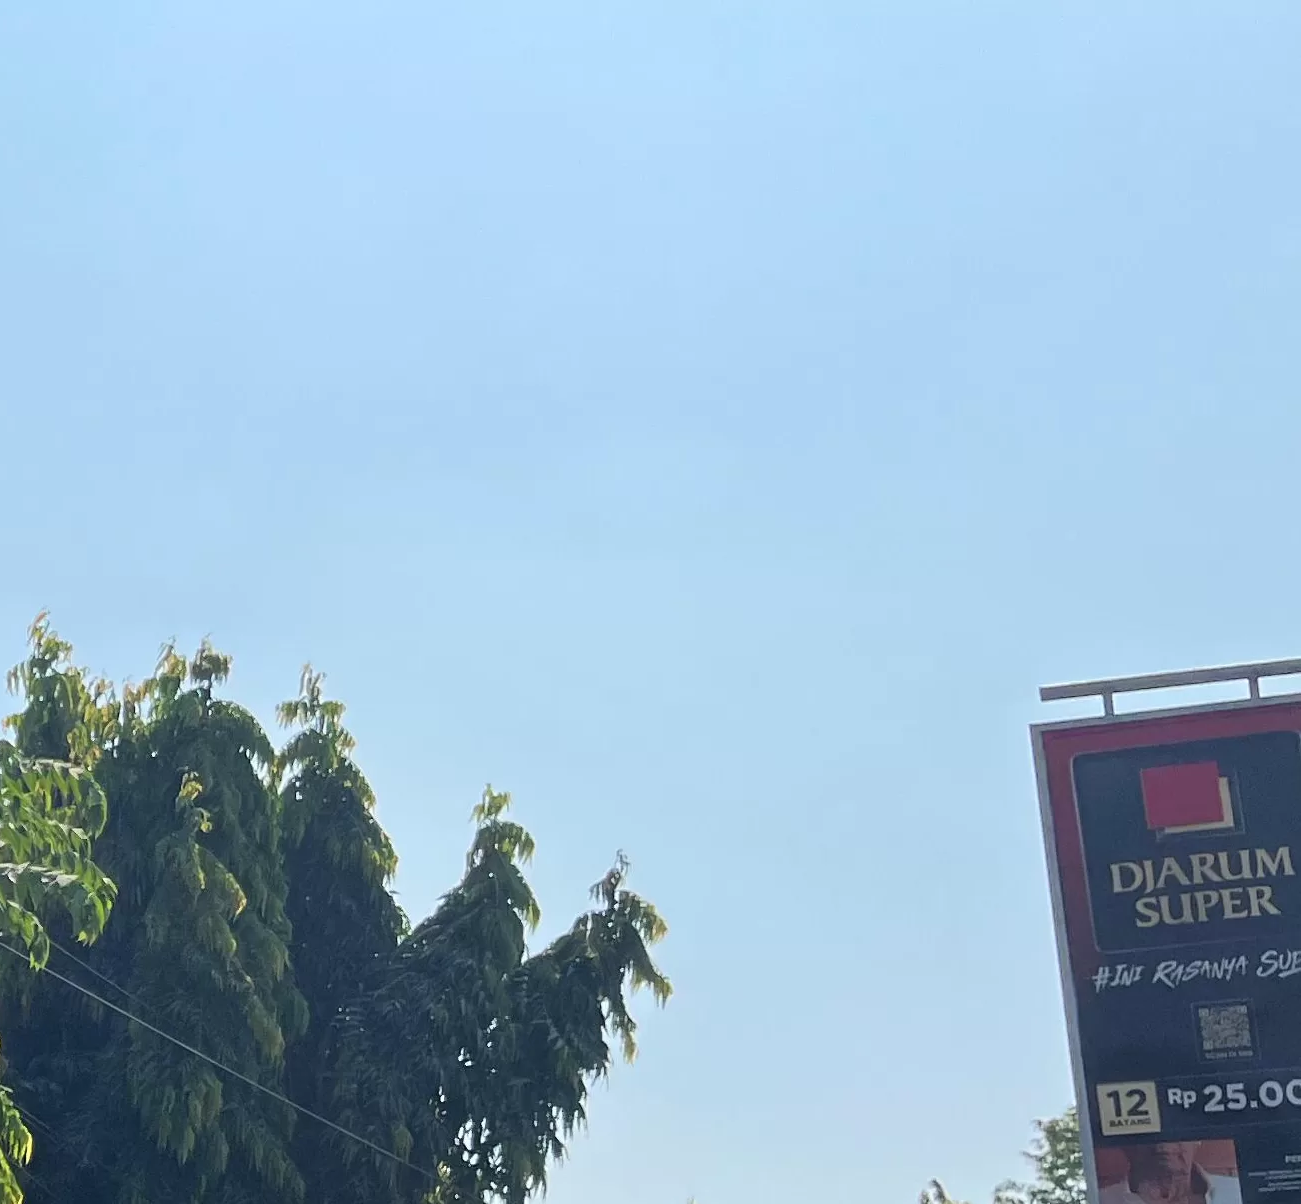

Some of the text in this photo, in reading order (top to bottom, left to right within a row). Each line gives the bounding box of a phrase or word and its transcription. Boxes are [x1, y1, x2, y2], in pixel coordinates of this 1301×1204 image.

[1110, 846, 1296, 894] DJARUM
[1135, 885, 1282, 928] SUPER
[1092, 963, 1146, 992] #INI
[1151, 955, 1249, 988] RASANYA
[1106, 1088, 1150, 1117] 12
[1167, 1088, 1197, 1109] Rp
